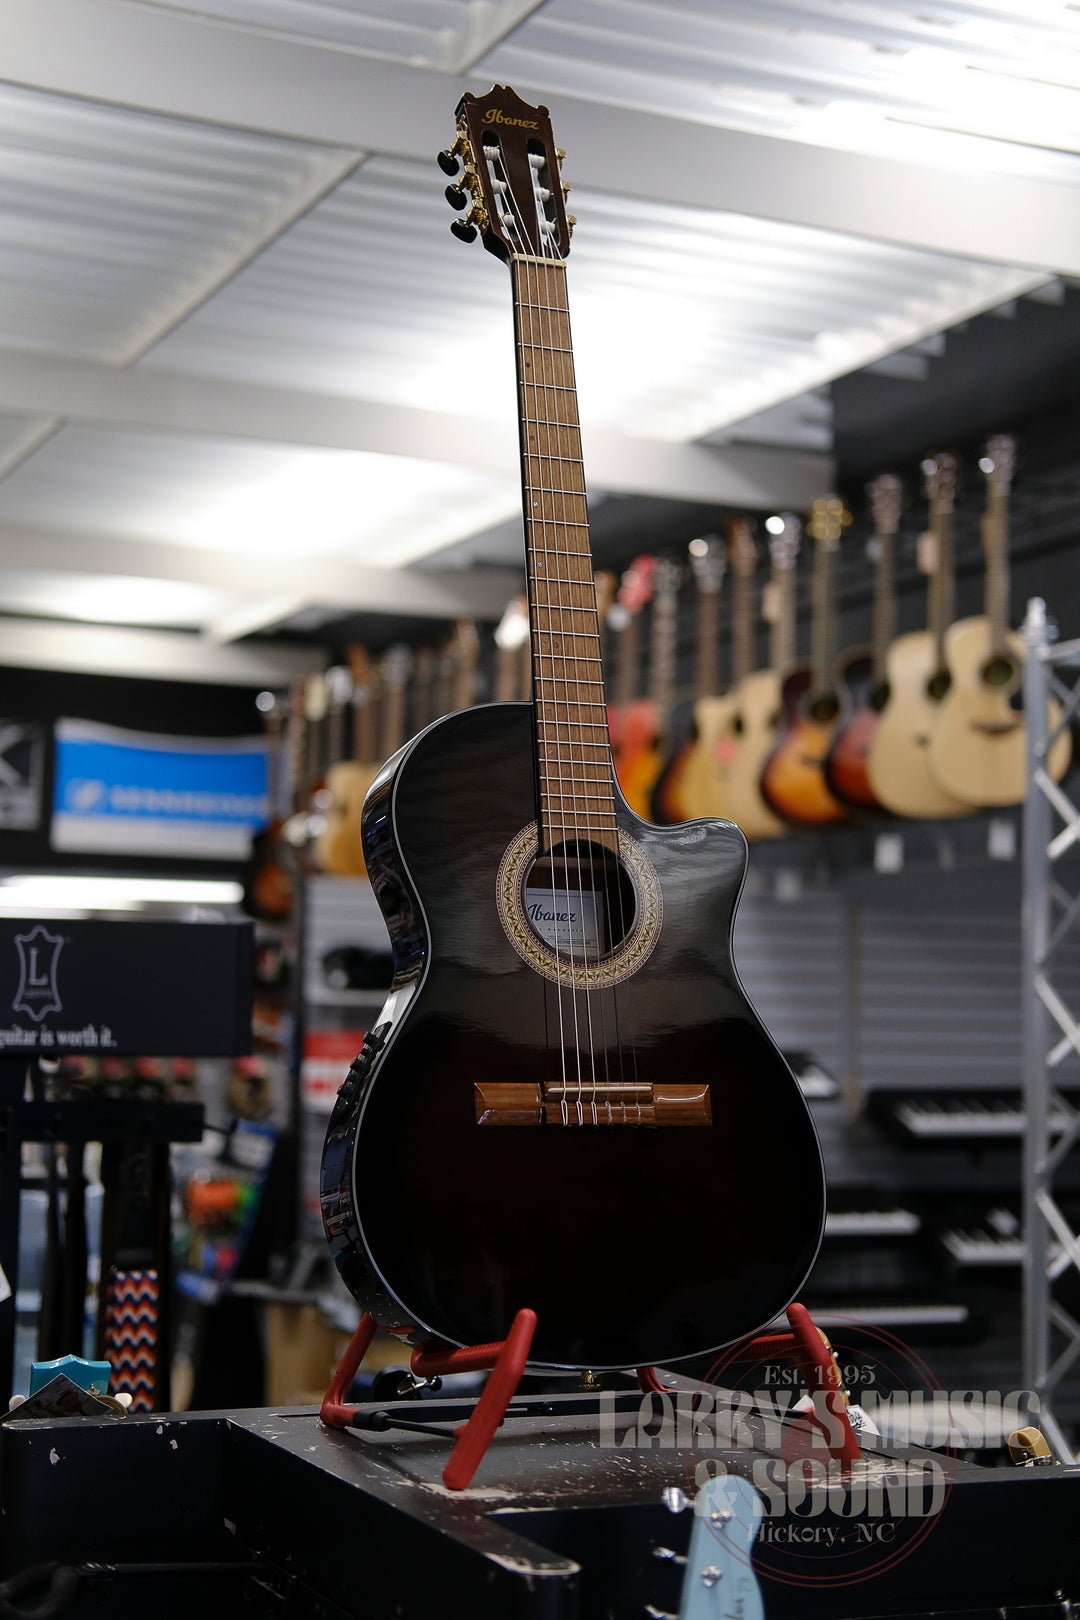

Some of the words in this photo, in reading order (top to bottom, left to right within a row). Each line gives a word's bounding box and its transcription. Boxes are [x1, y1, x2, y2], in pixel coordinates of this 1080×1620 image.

[482, 108, 539, 130] Ibanez
[527, 903, 577, 923] Ibanez
[29, 947, 48, 986] L
[40, 1024, 55, 1047] is
[56, 1024, 98, 1047] worth
